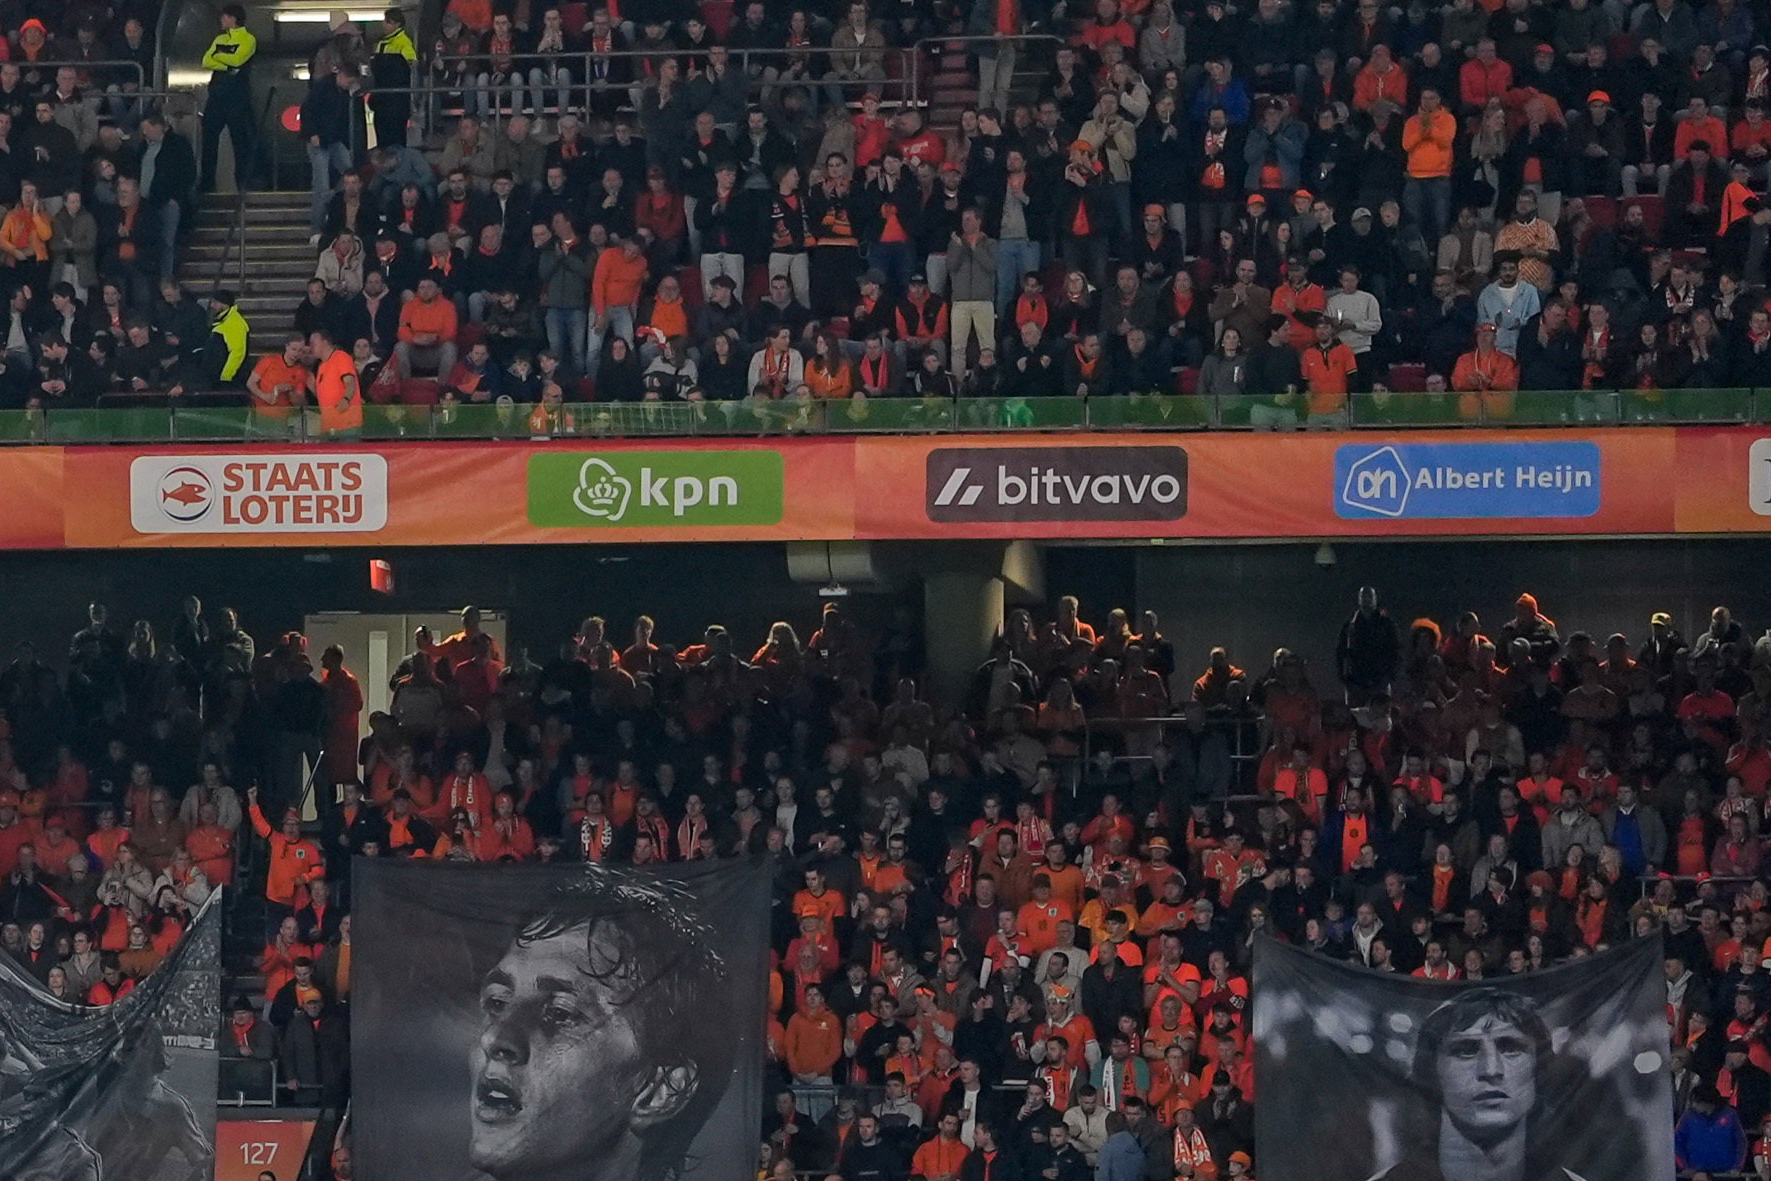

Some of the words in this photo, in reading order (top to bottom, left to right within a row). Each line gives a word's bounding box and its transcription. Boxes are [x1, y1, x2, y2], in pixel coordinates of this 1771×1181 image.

[223, 462, 362, 492] STAATS
[641, 466, 738, 516] kpn
[998, 465, 1180, 505] bitvavo
[1415, 466, 1505, 489] Albert
[1517, 464, 1592, 494] Heijn
[223, 494, 362, 525] LOTERIJ
[240, 1142, 278, 1164] 127
